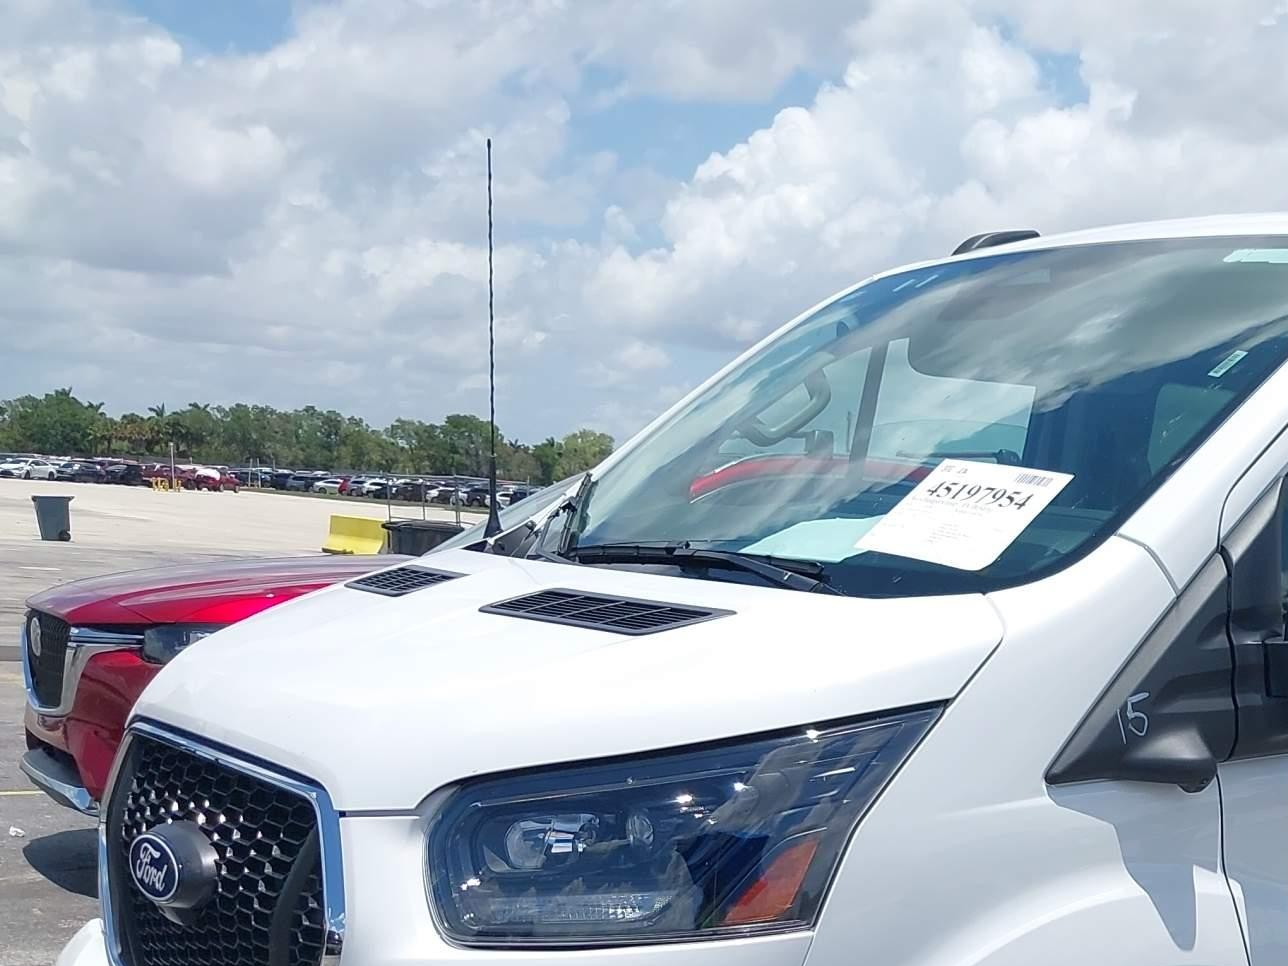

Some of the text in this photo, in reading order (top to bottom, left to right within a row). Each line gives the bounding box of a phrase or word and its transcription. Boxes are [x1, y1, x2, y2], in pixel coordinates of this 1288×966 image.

[926, 481, 1034, 510] 45197954
[1117, 692, 1150, 744] 15
[136, 842, 168, 892] Ford
